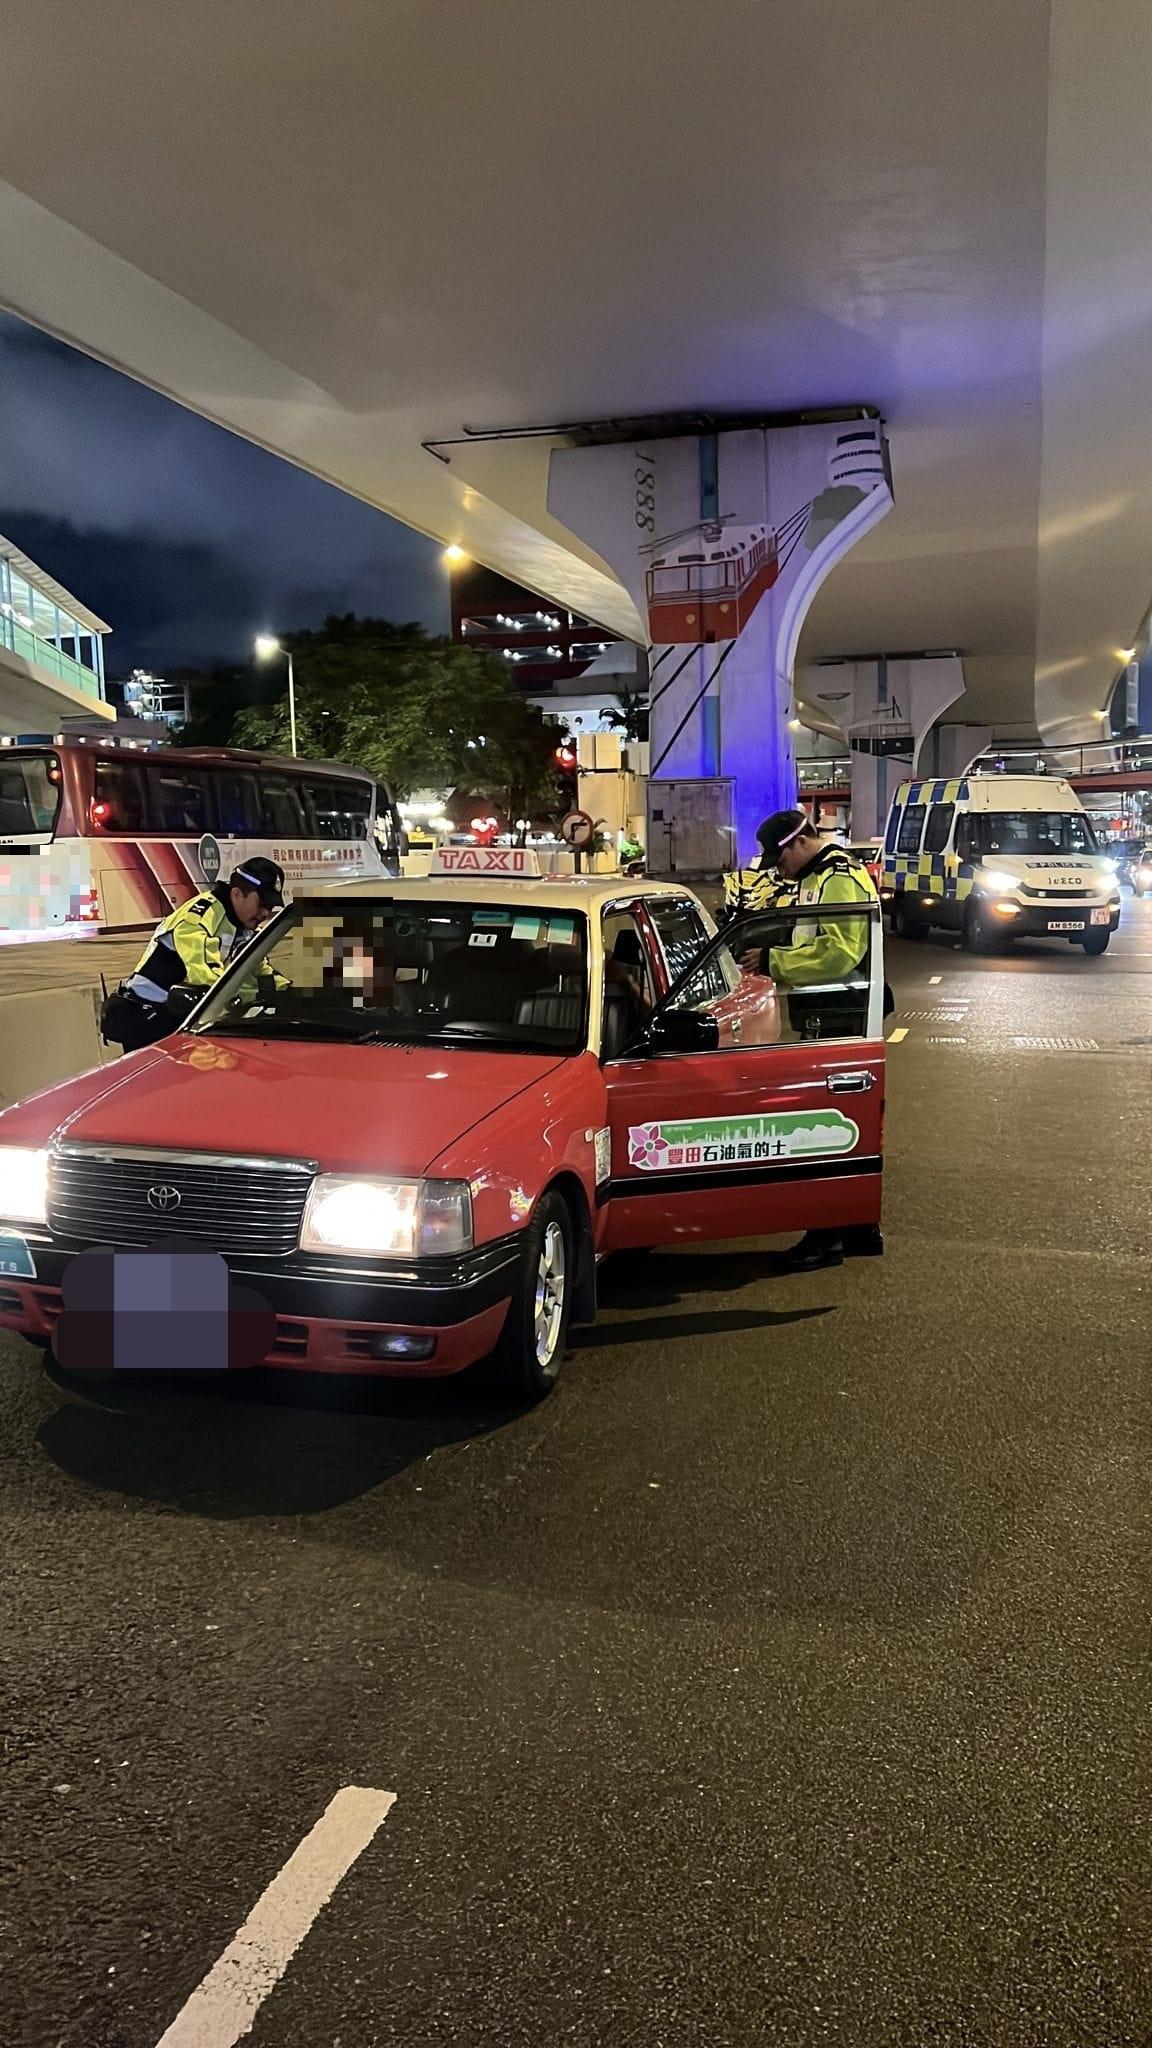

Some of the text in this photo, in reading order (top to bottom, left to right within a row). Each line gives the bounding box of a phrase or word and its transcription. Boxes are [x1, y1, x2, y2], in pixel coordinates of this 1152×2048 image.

[634, 451, 656, 533] 1888
[439, 850, 525, 872] TAXI
[667, 1140, 787, 1165] 豐田石油氣的士
